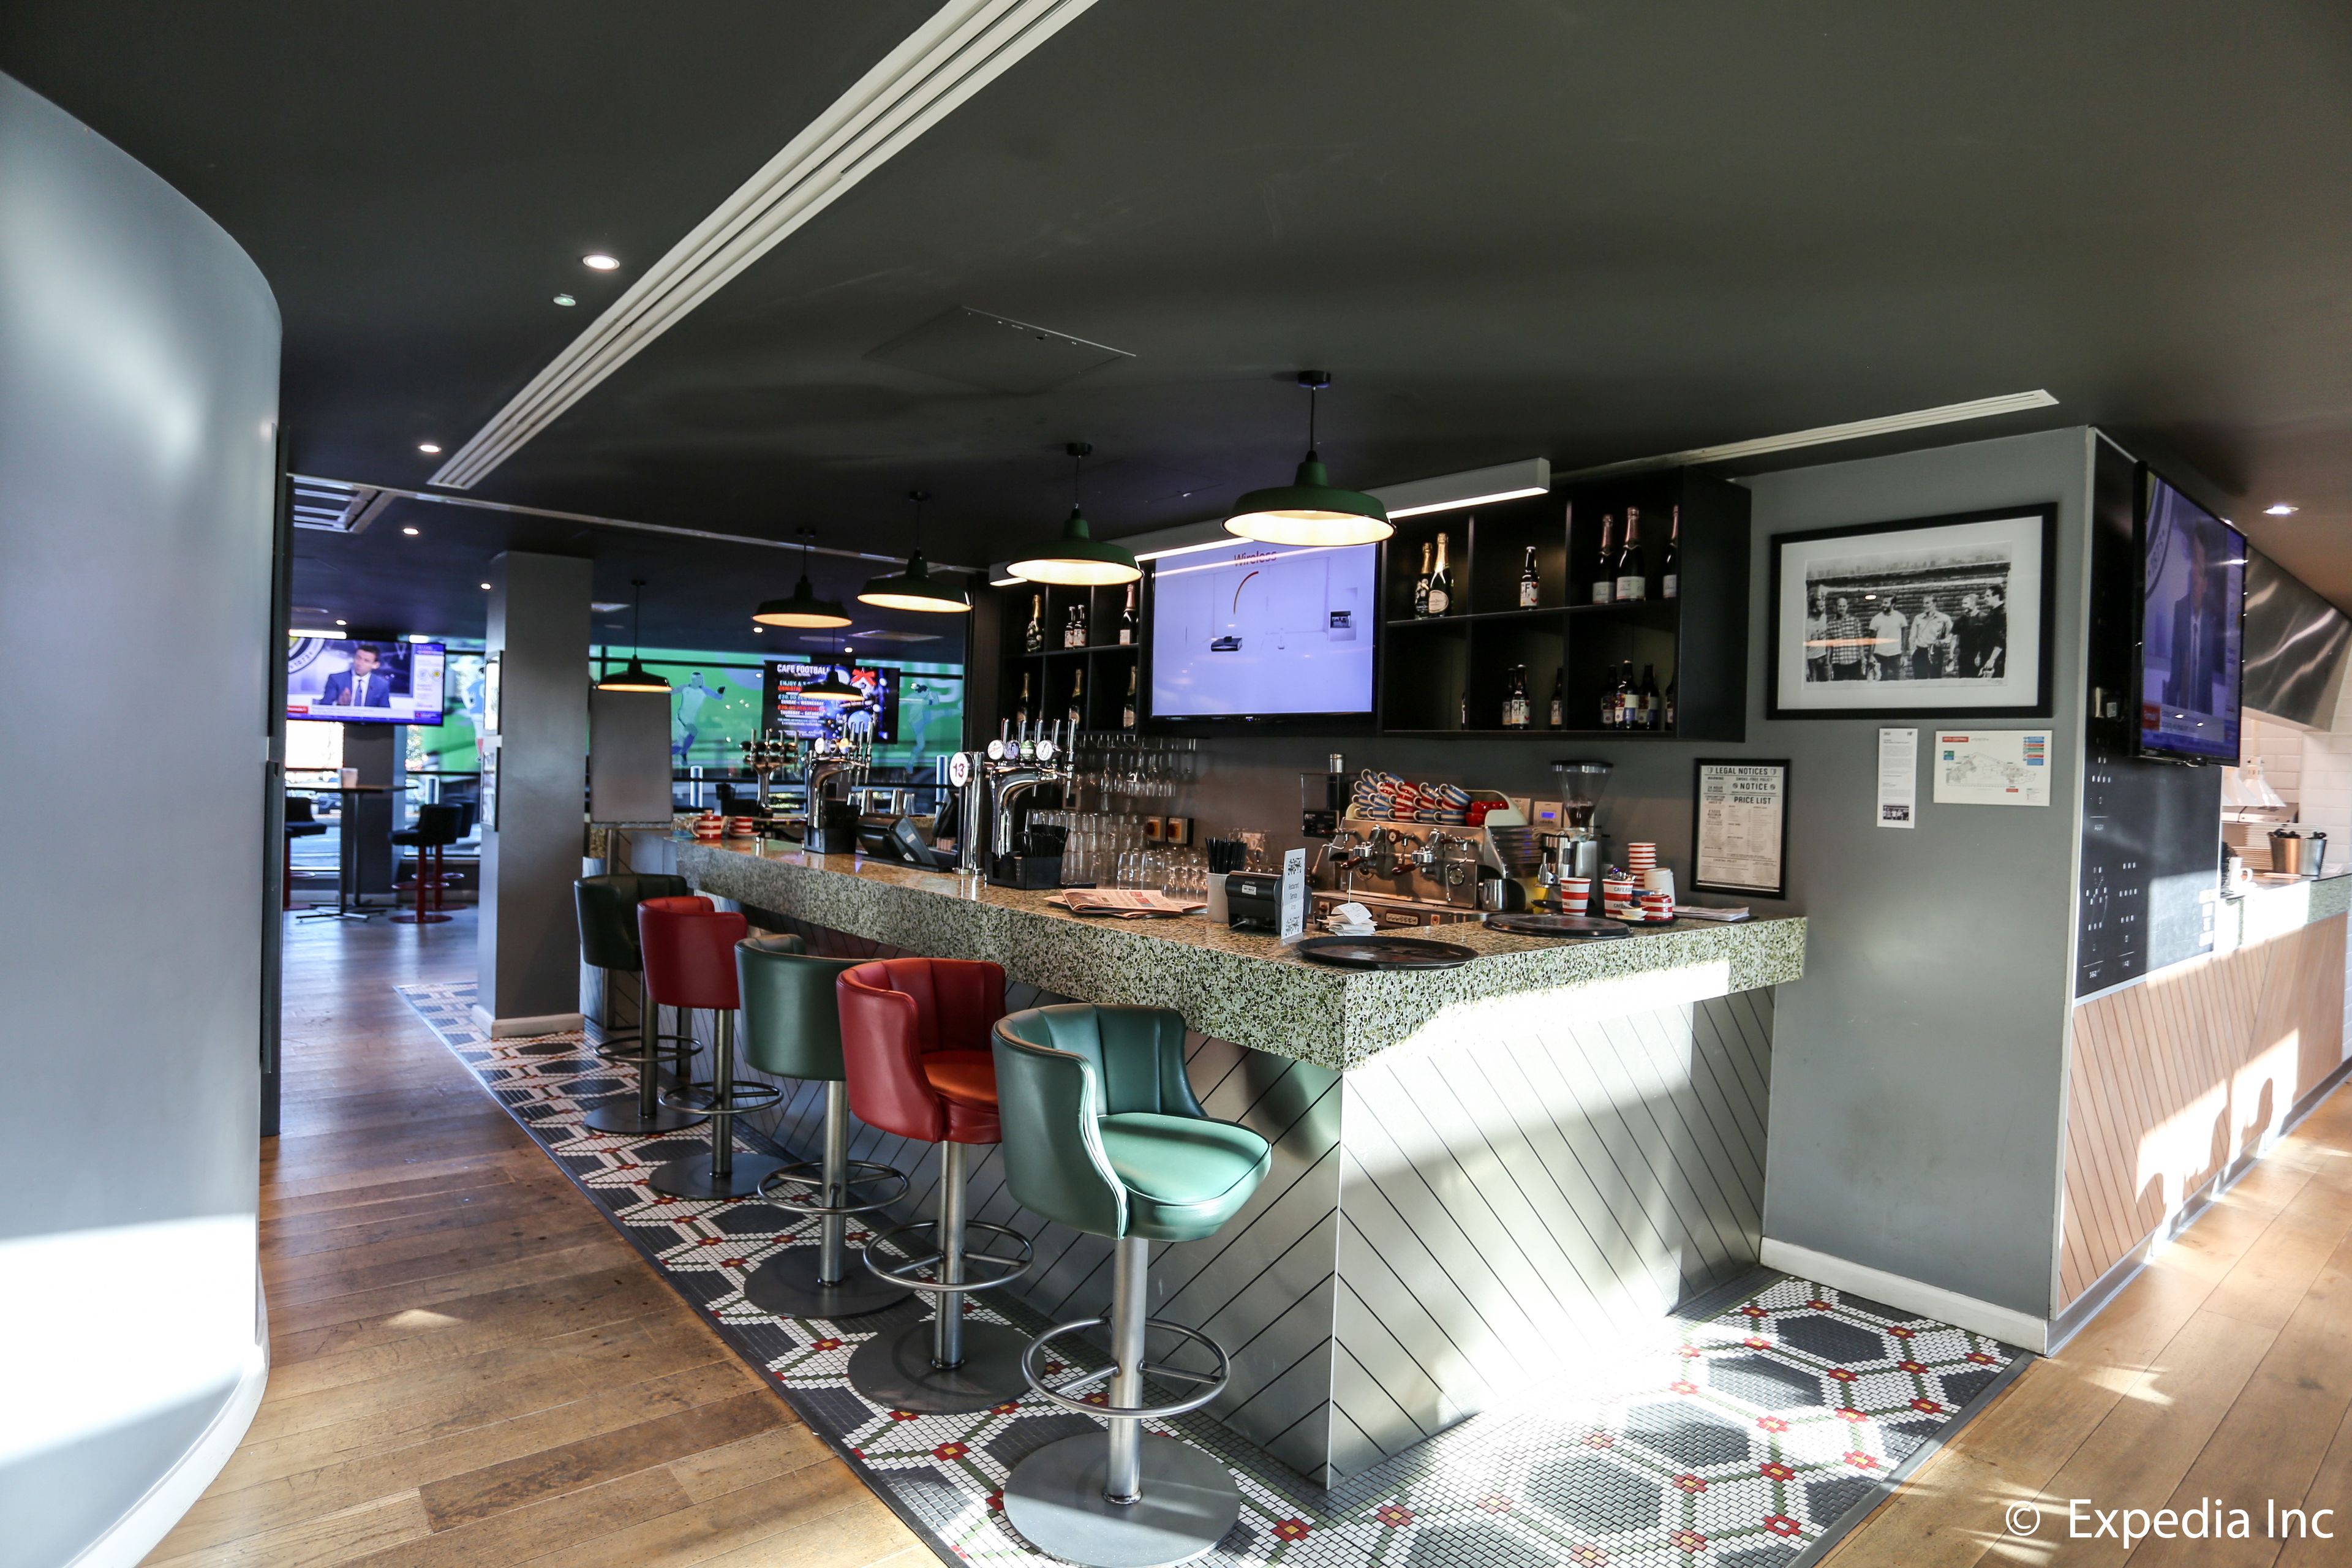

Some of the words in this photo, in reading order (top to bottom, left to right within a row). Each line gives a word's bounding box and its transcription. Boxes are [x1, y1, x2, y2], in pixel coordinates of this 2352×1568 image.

[1234, 551, 1276, 567] Wireless
[777, 664, 795, 673] CAFE
[953, 763, 965, 778] 13
